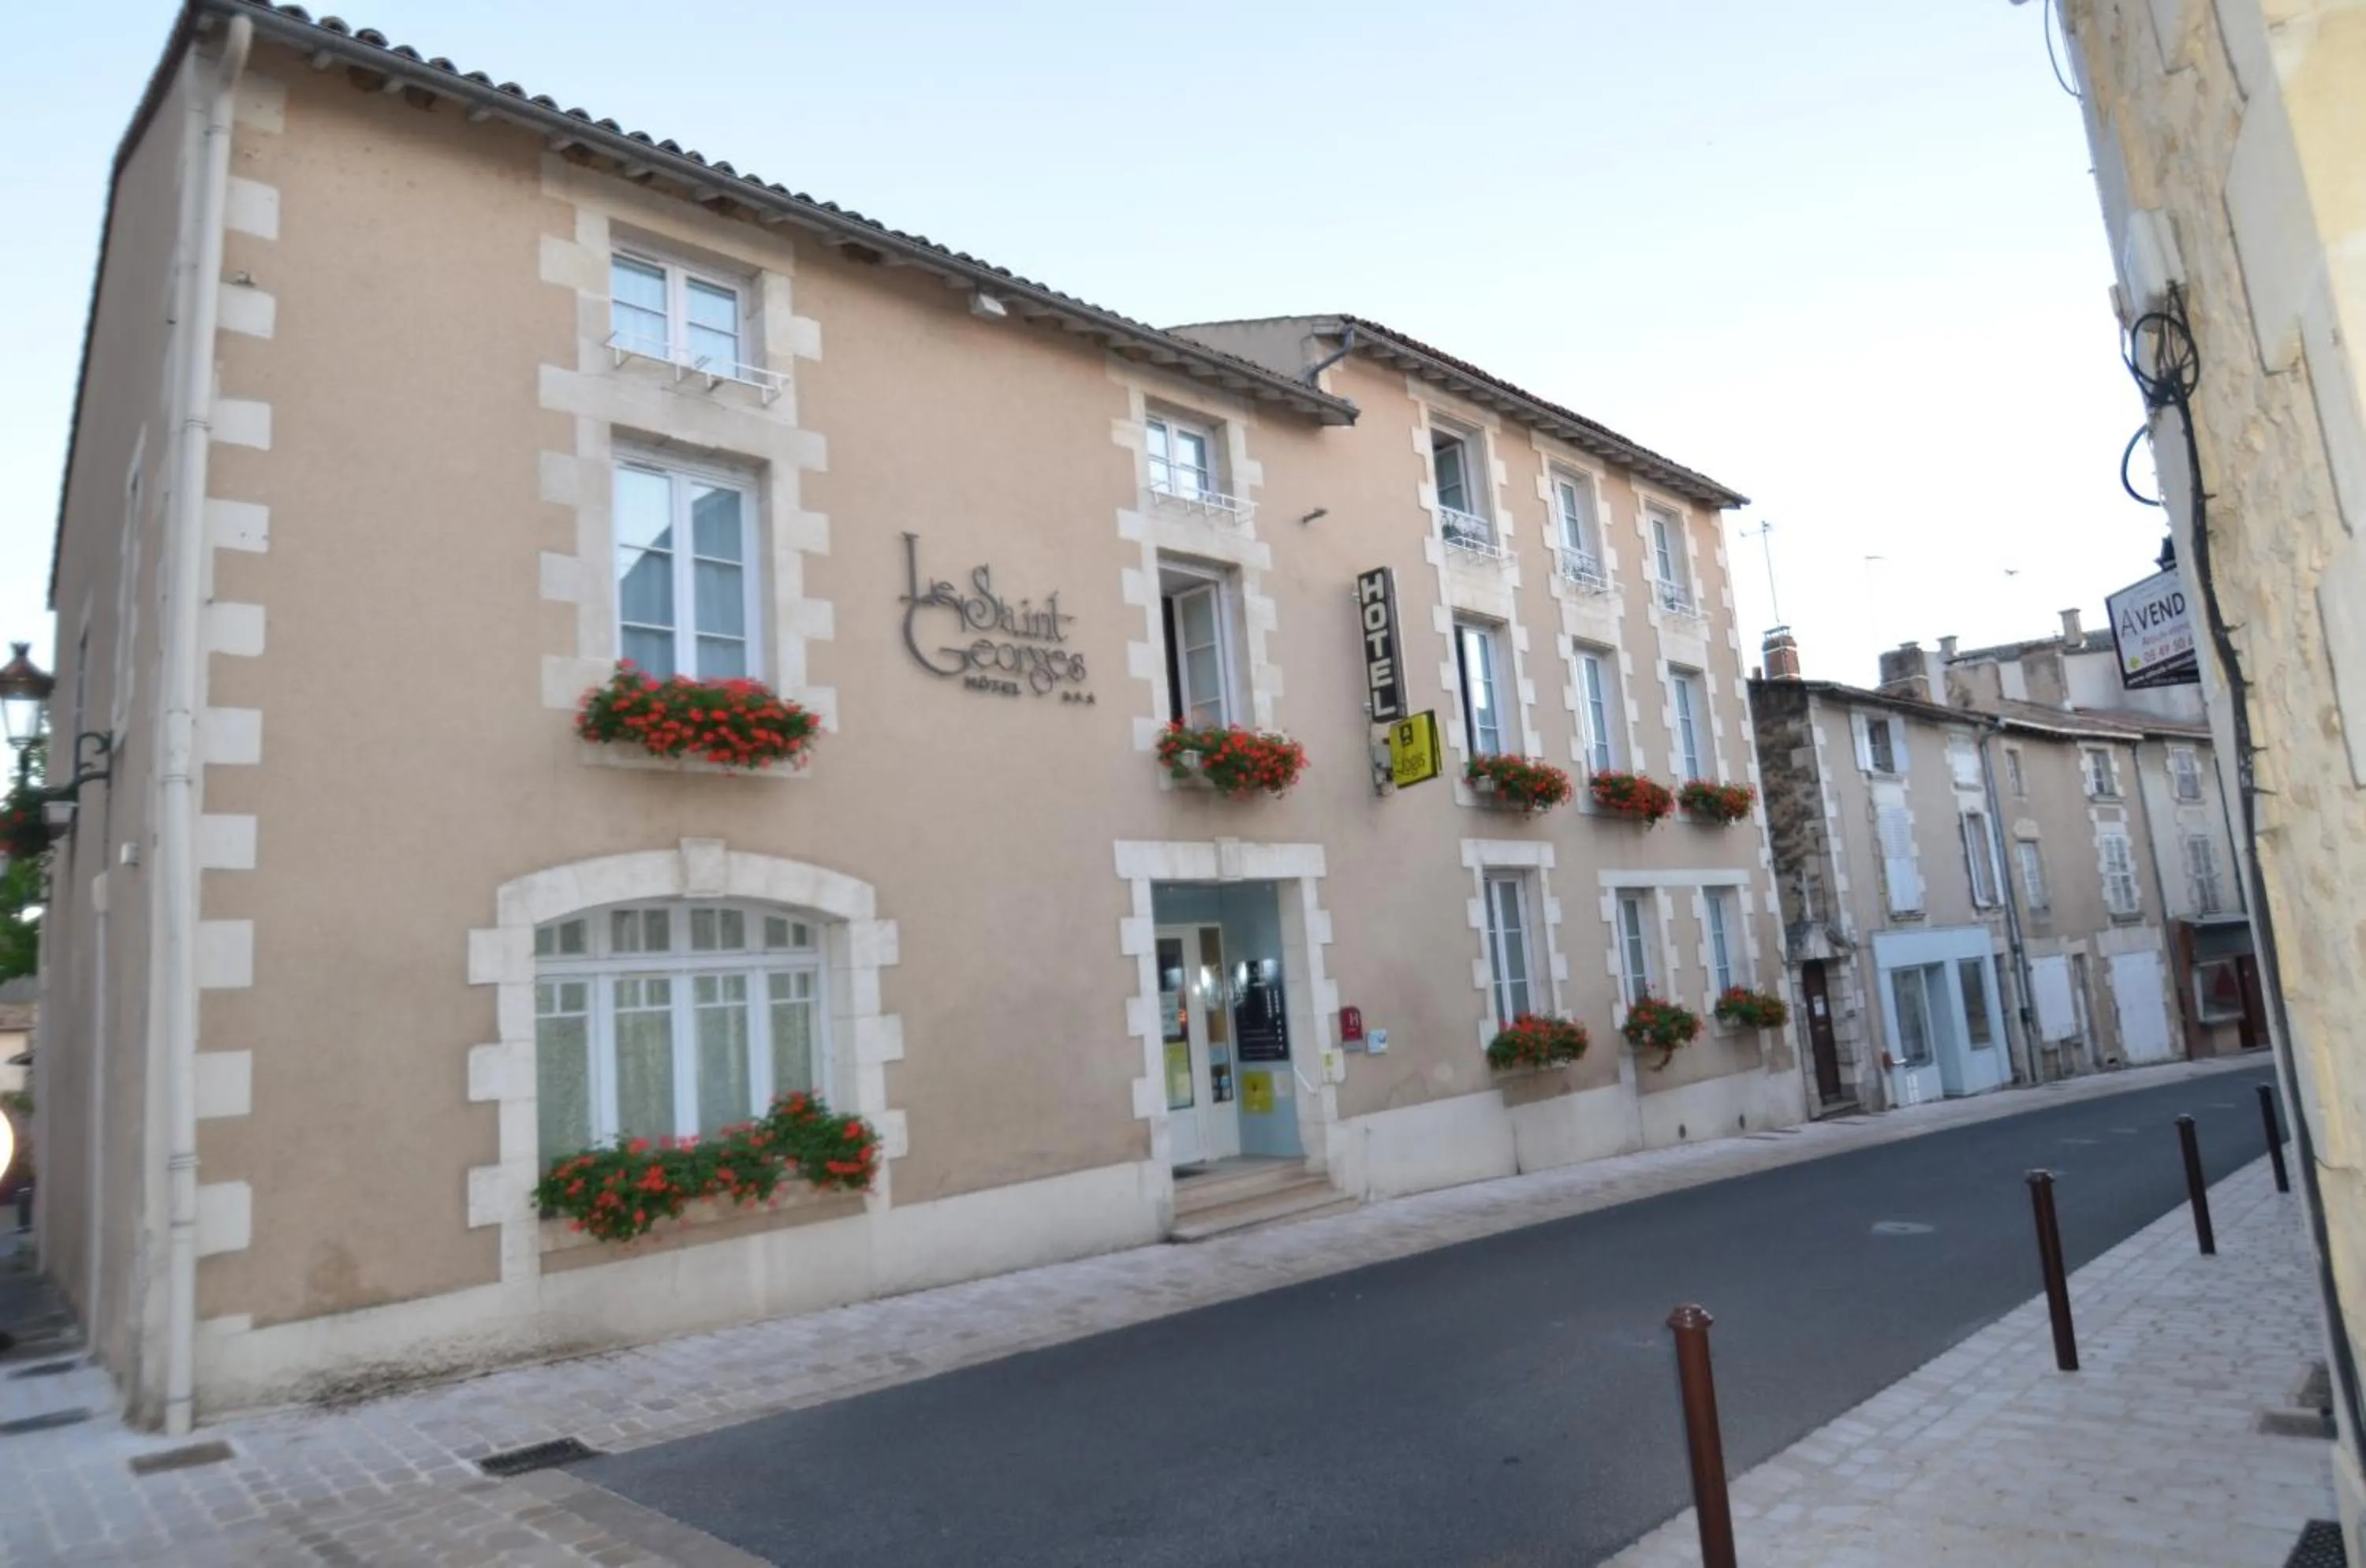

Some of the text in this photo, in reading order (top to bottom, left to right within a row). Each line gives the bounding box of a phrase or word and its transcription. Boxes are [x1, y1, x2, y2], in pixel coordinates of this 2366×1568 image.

[902, 593, 1087, 696] Georges
[965, 562, 1077, 643] Saint
[1360, 573, 1398, 717] HOTEL
[2134, 592, 2186, 631] VEND
